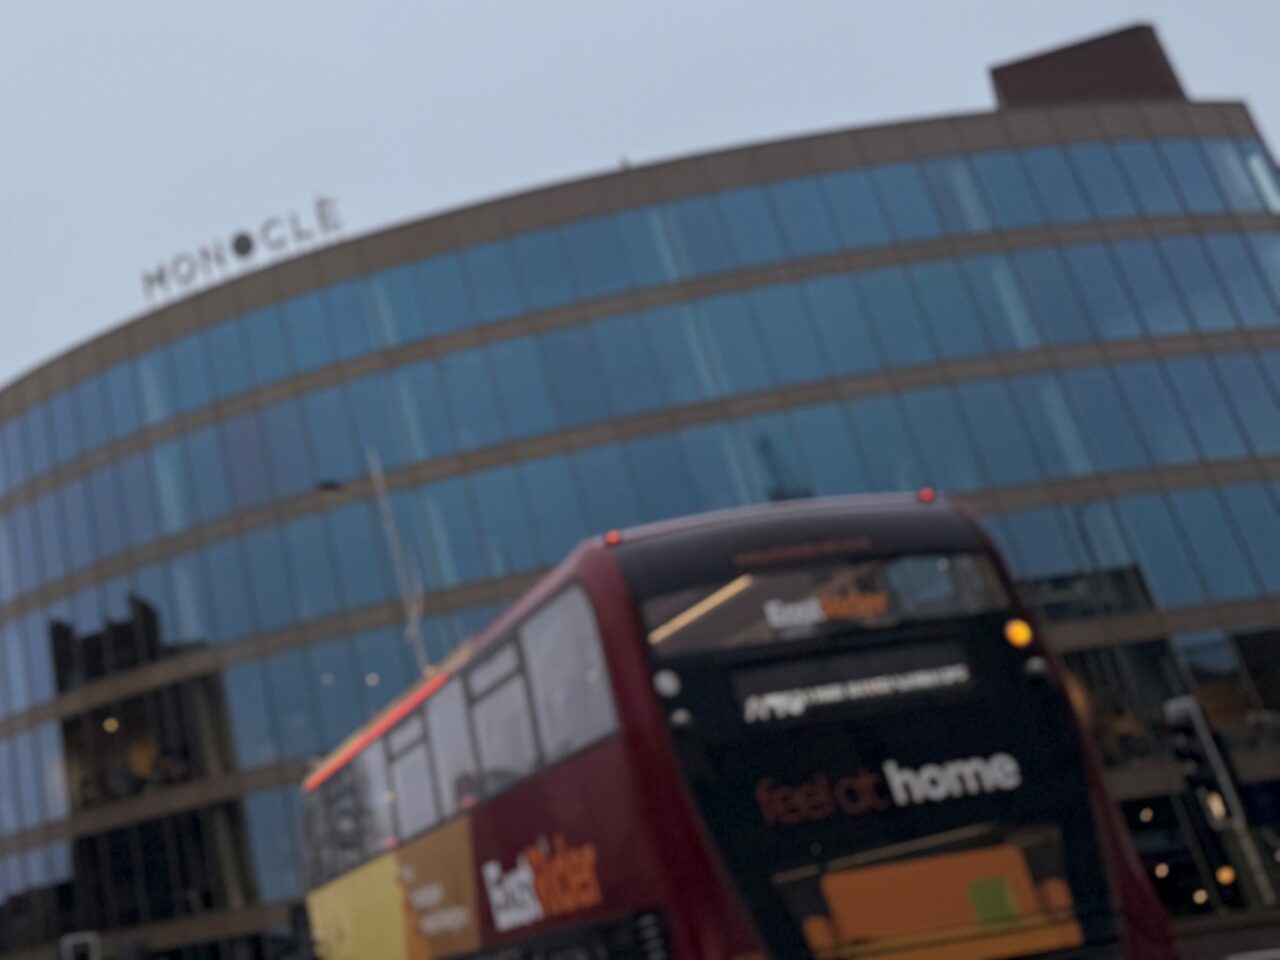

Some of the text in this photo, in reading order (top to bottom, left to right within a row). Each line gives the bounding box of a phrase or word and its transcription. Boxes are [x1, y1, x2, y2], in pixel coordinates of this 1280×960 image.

[755, 752, 1021, 826] feel at home
